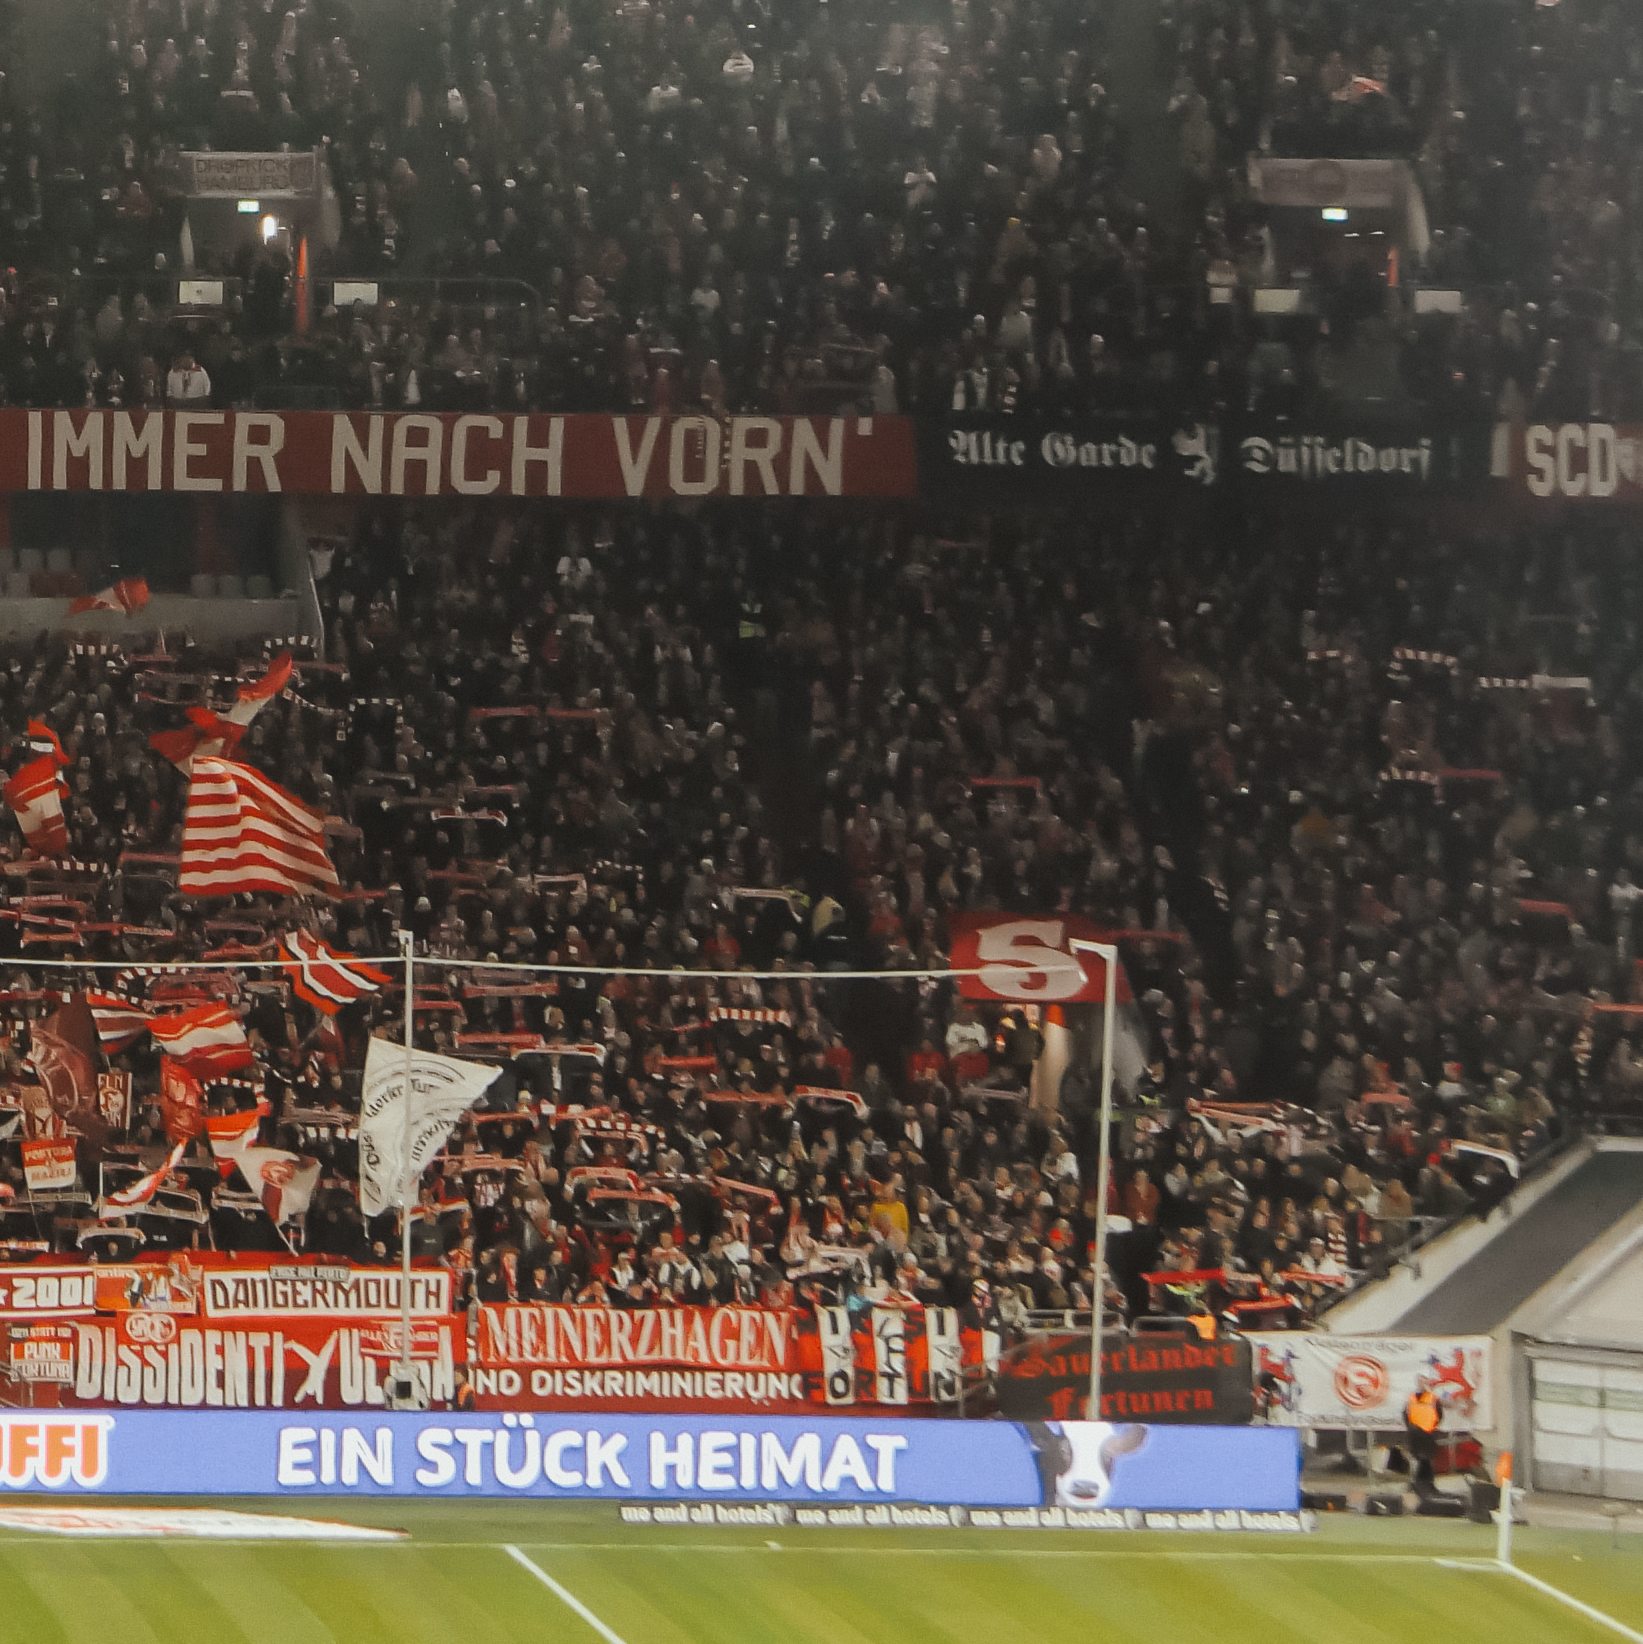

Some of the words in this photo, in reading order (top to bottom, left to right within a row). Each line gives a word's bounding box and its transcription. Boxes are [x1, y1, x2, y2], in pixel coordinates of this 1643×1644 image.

[26, 410, 285, 492] IMMER
[330, 414, 565, 497] NACH
[948, 429, 1025, 467] Alte
[1040, 432, 1157, 473] Garde
[1242, 434, 1433, 481] Düsseldorf
[1526, 422, 1618, 497] SCD
[11, 1272, 95, 1308] 2001
[23, 1342, 62, 1360] PUNK
[484, 1305, 789, 1370] MEINERZHAGEN
[277, 1426, 395, 1486] EIN
[415, 1413, 631, 1488] STÜCK
[649, 1431, 907, 1492] HEIMAT
[621, 1506, 651, 1523] me
[653, 1503, 689, 1524] and
[690, 1503, 715, 1524] all
[716, 1504, 775, 1525] hotels
[796, 1508, 826, 1525] me
[828, 1505, 864, 1526] and
[865, 1505, 890, 1526] all
[891, 1505, 950, 1527] hotels
[1002, 1507, 1039, 1527] and
[1040, 1507, 1065, 1527] all
[1066, 1507, 1126, 1528] hotels
[1177, 1509, 1214, 1530] and
[1215, 1509, 1241, 1529] all
[1241, 1510, 1301, 1531] hotels
